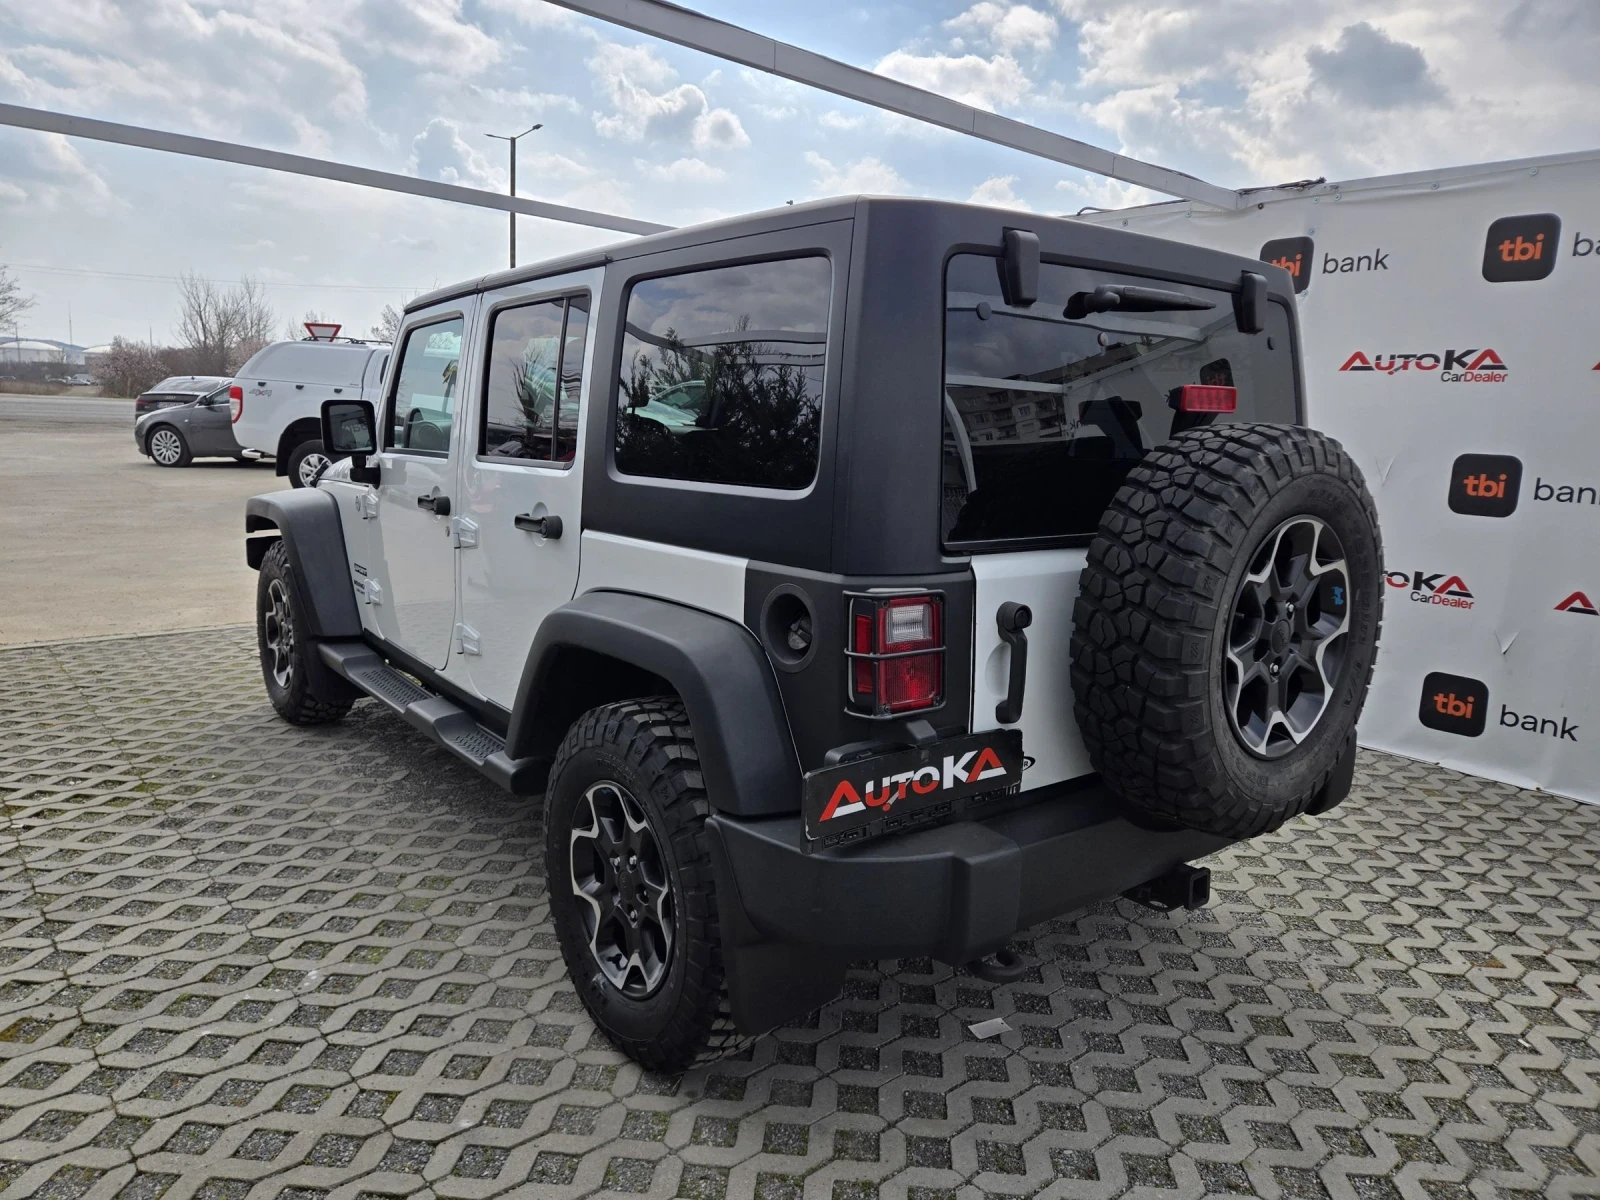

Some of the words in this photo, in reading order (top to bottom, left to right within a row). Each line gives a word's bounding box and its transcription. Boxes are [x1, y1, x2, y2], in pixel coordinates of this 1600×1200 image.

[1322, 248, 1390, 275] bank
[1498, 233, 1545, 262] tbi
[1572, 232, 1600, 257] b
[1440, 370, 1509, 383] CarDealer
[1463, 473, 1509, 498] tbi
[1533, 477, 1600, 506] ban
[1384, 570, 1475, 599] OKA
[1410, 591, 1475, 610] CarDealer
[1433, 691, 1476, 719] tbi
[1499, 703, 1579, 742] bank
